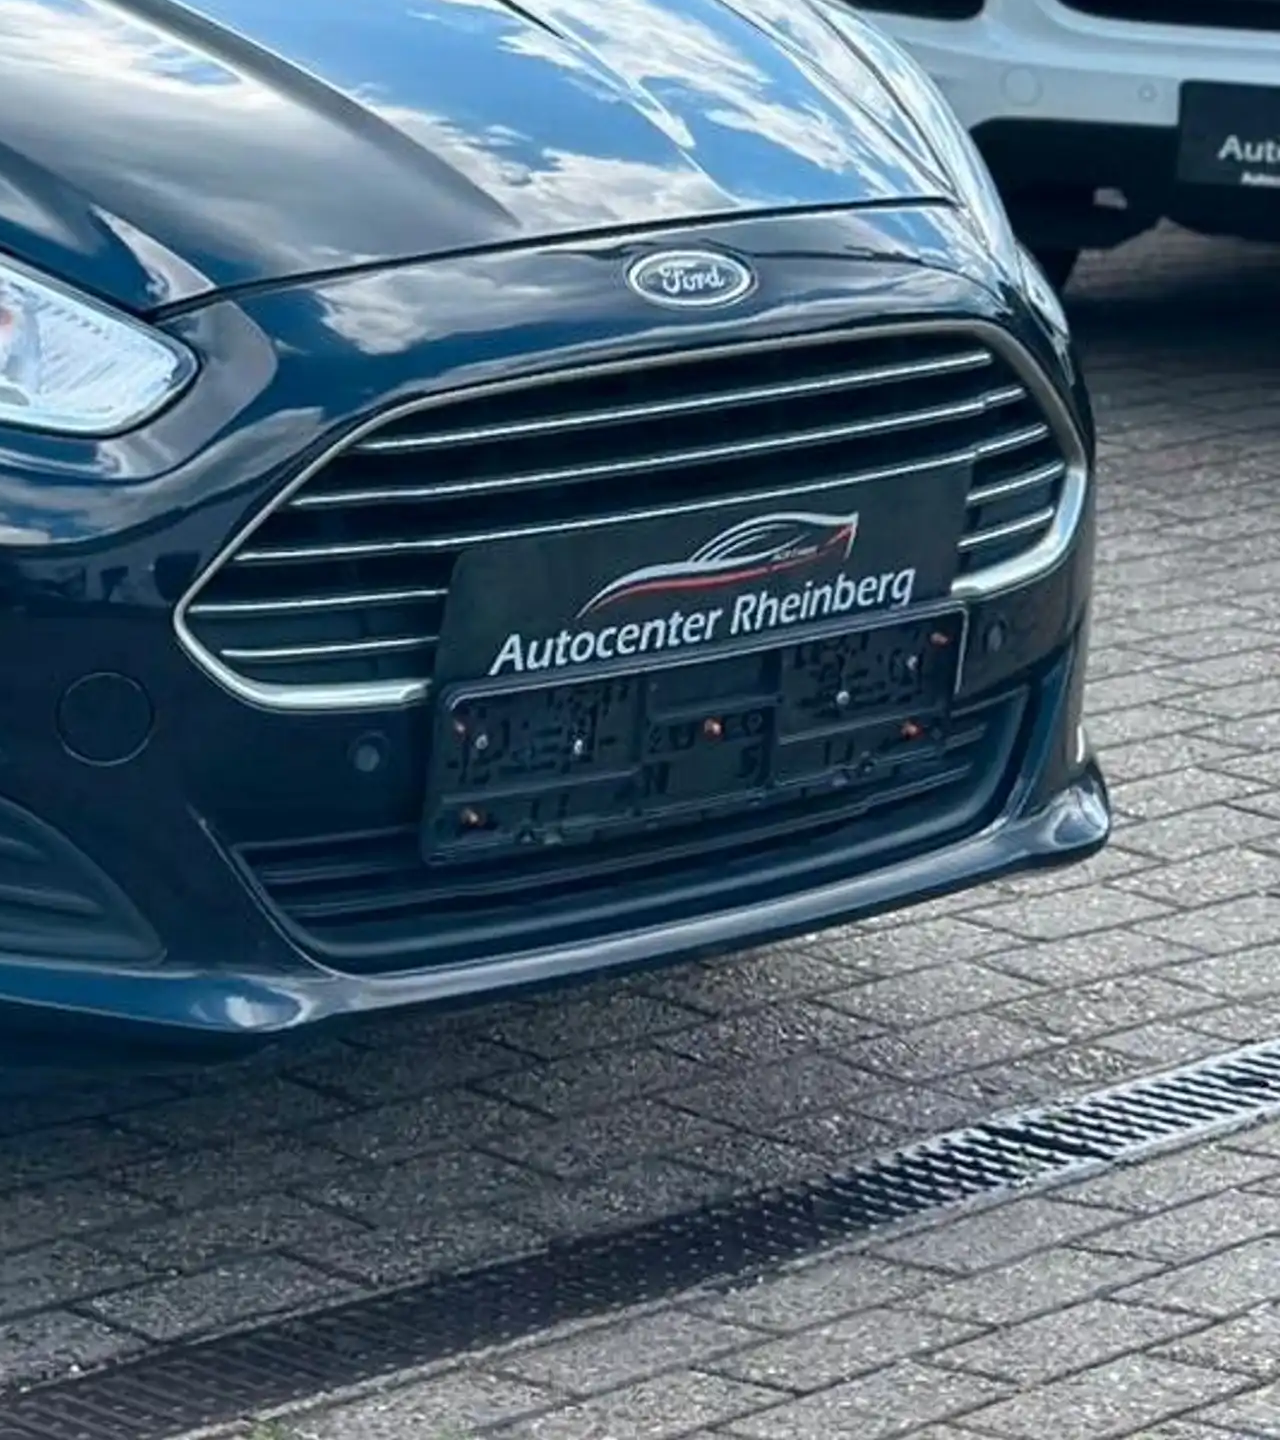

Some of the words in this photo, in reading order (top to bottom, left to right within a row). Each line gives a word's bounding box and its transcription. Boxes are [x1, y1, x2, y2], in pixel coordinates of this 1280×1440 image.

[1218, 134, 1280, 164] Aut
[659, 261, 725, 294] Ford
[488, 608, 723, 676] Autocenter
[730, 567, 916, 635] Rheinberg
